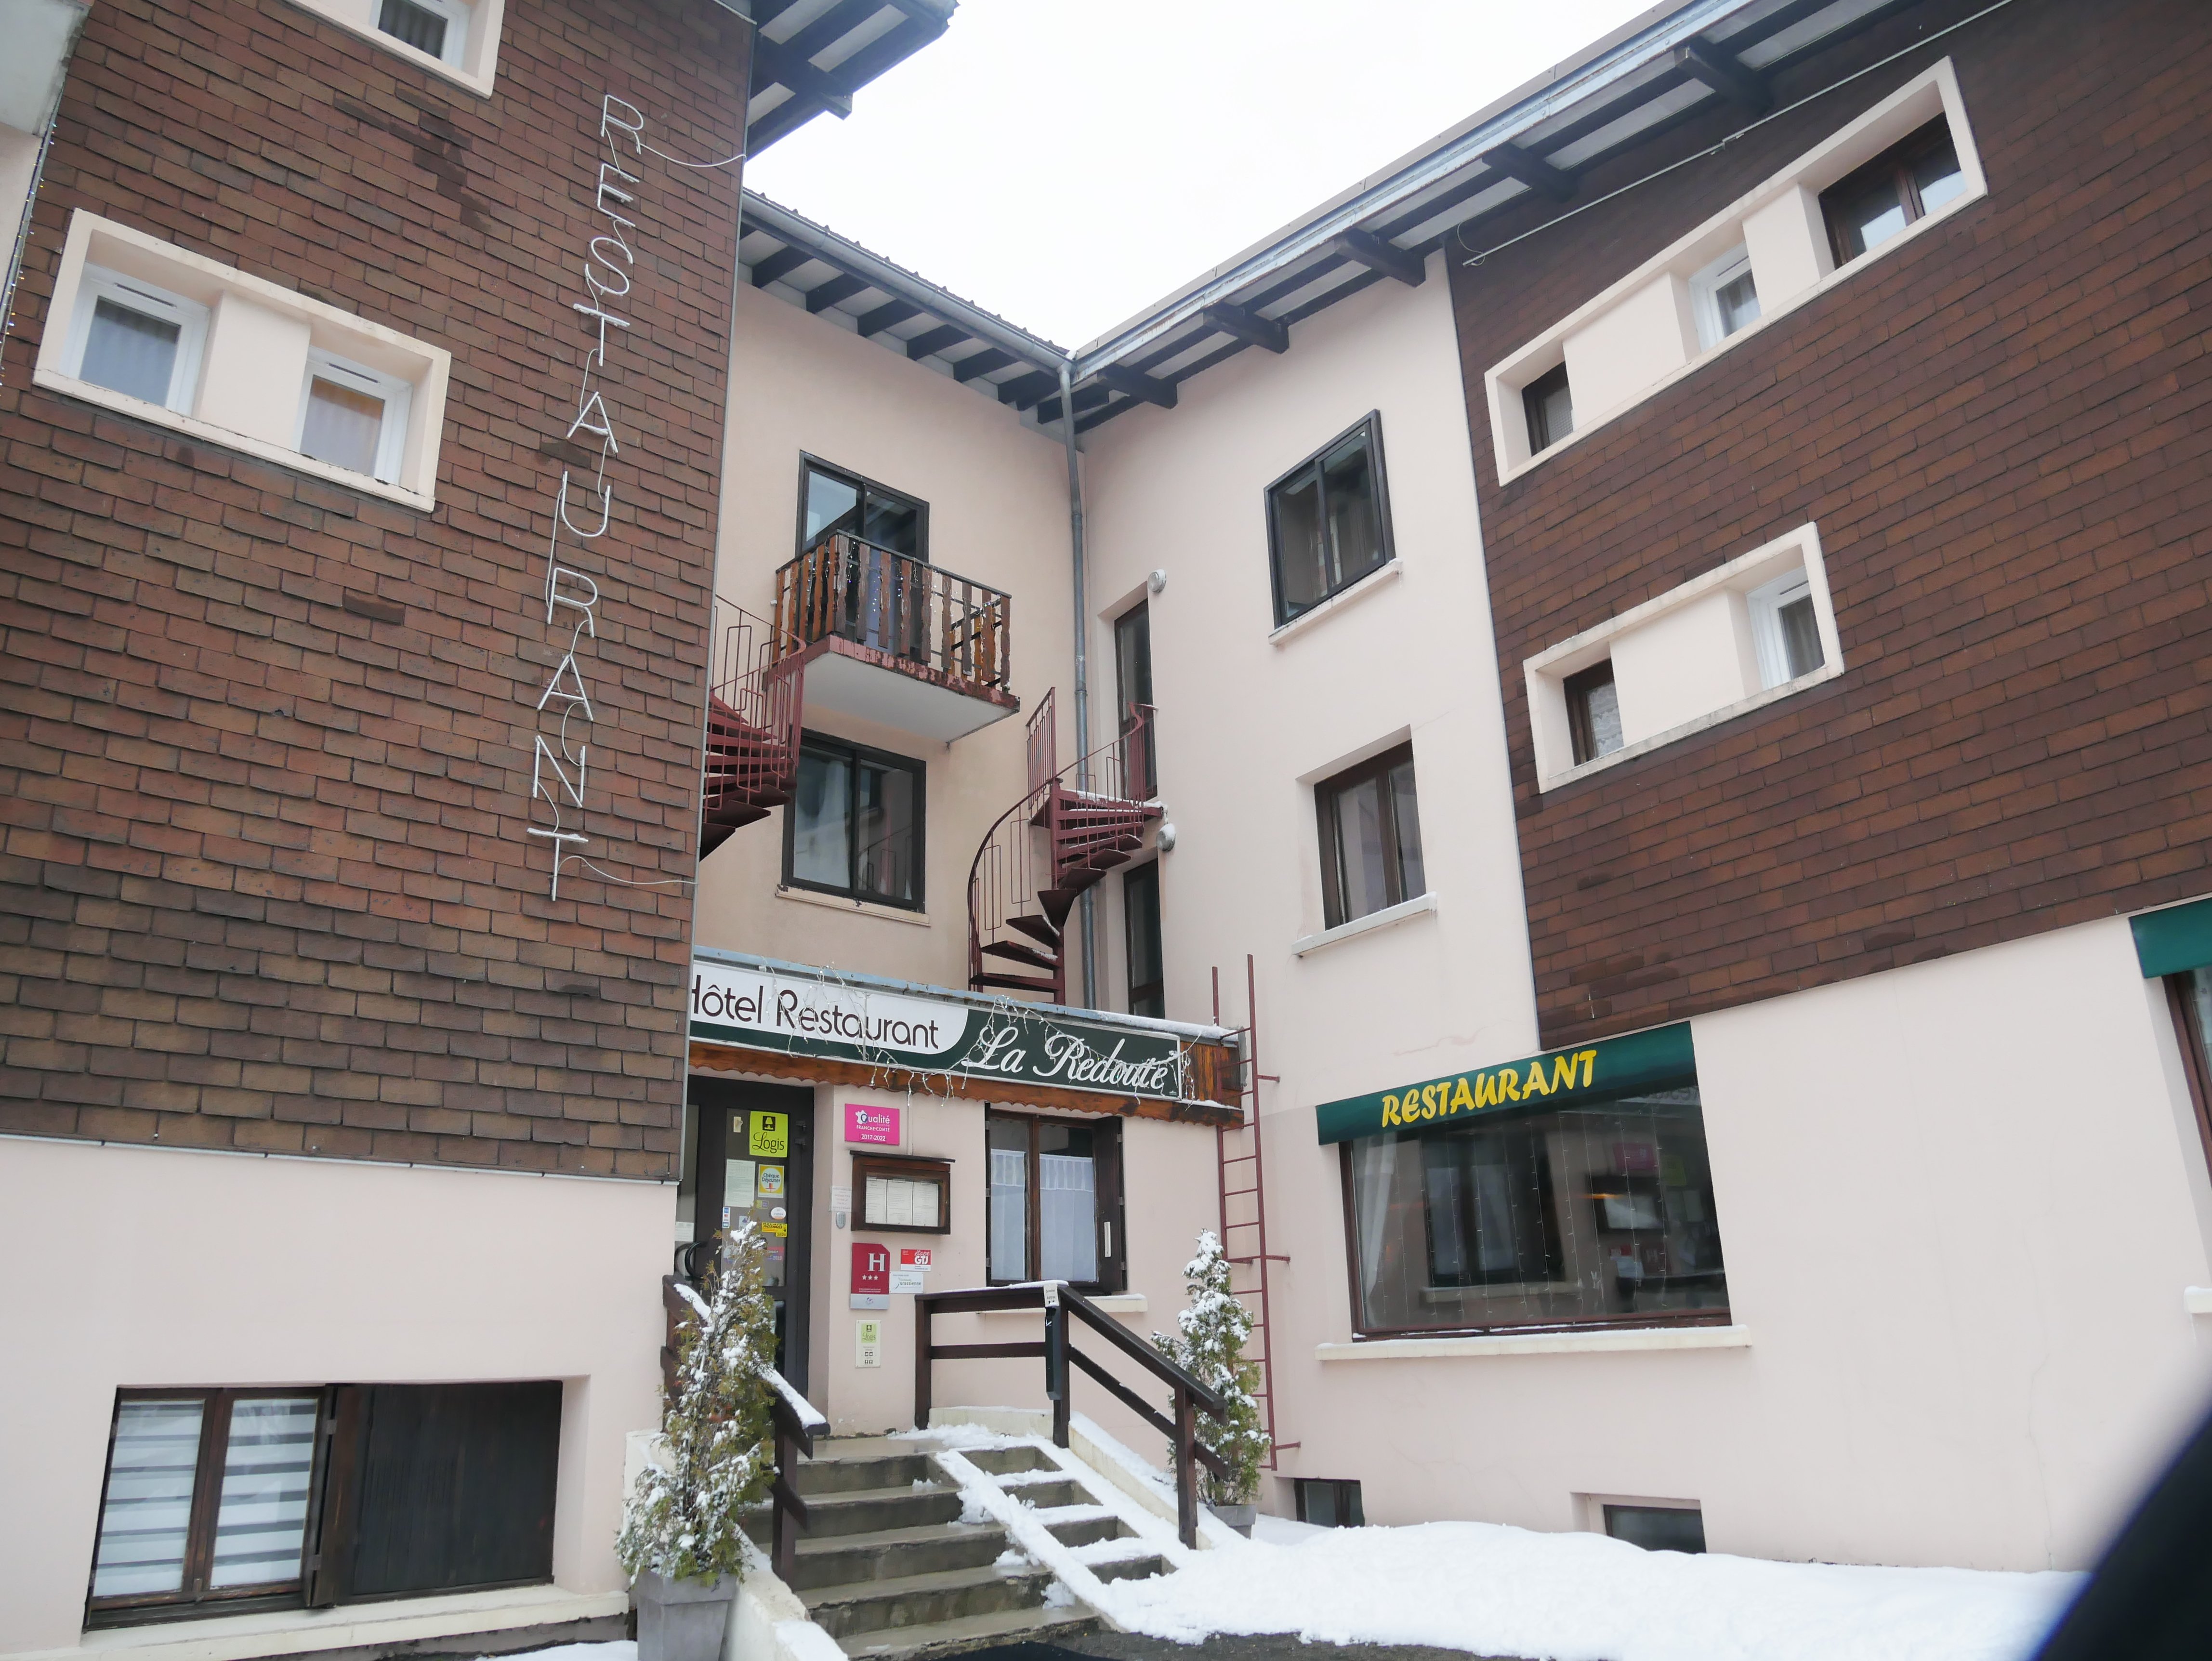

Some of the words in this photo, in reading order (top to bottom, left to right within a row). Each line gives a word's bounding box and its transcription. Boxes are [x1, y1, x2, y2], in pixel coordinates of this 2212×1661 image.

[527, 94, 644, 902] RESTAURANT
[777, 989, 939, 1050] Restaurant
[961, 1026, 1026, 1073] La
[1381, 1050, 1597, 1128] RESTAURANT
[861, 1113, 890, 1124] Qualité
[752, 1132, 785, 1154] Logis
[868, 1253, 886, 1272] H
[915, 1255, 928, 1265] GTJ
